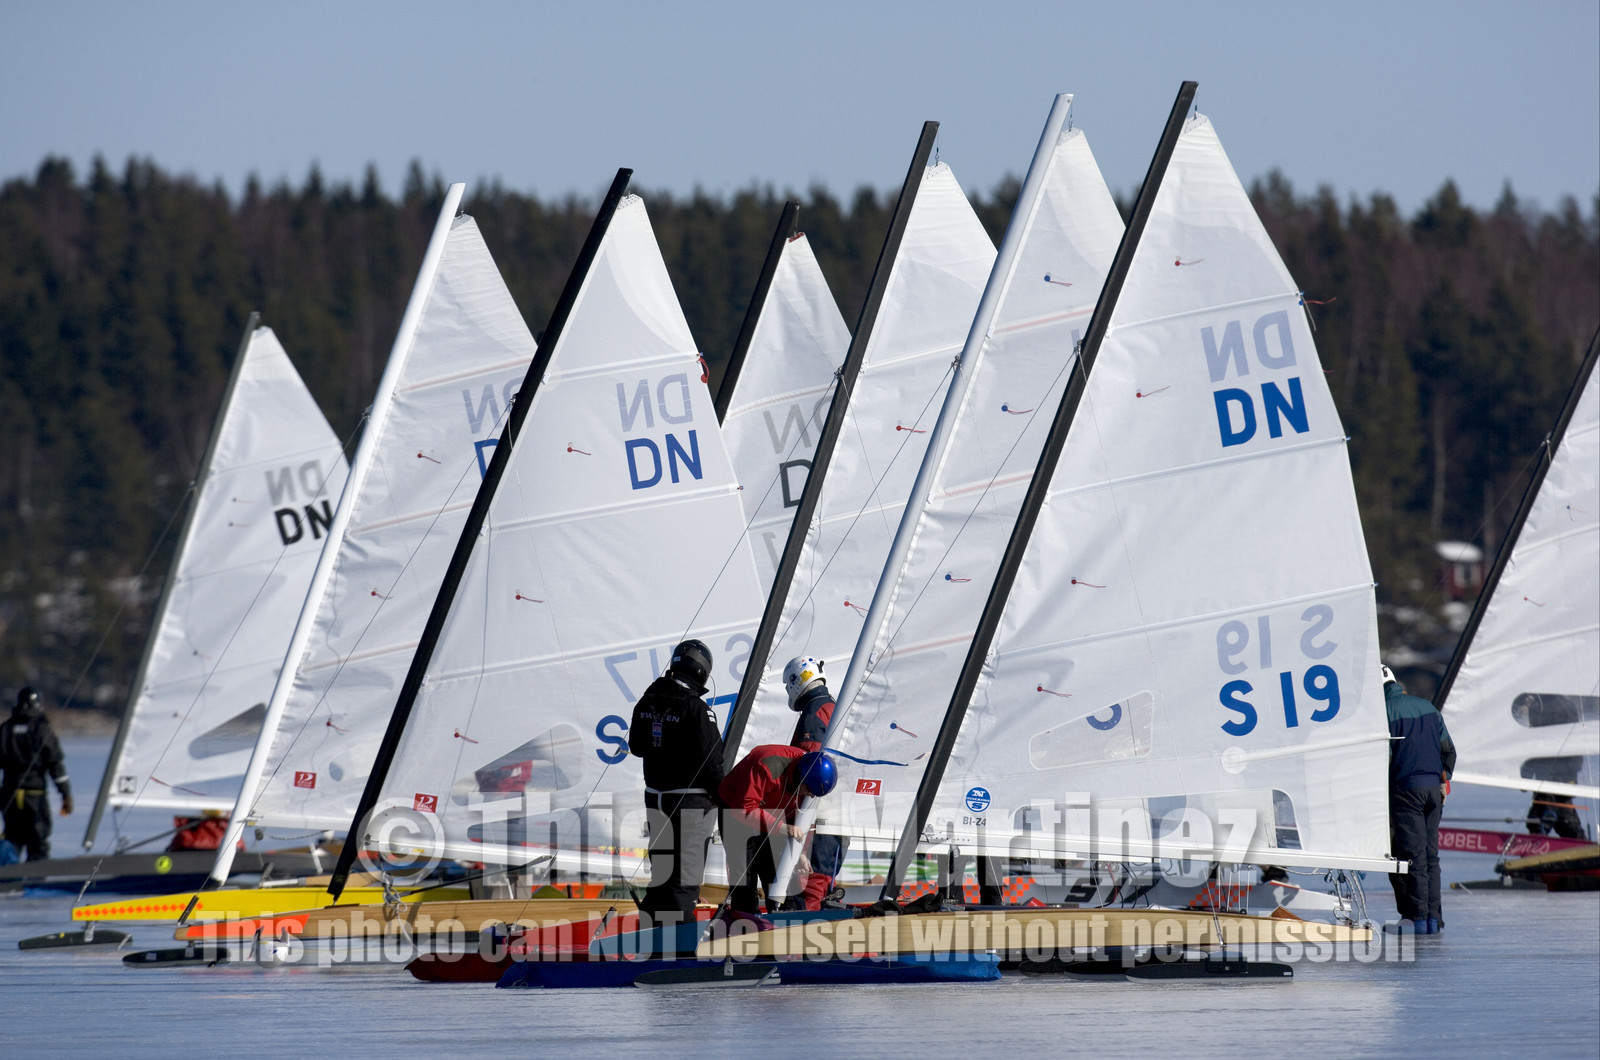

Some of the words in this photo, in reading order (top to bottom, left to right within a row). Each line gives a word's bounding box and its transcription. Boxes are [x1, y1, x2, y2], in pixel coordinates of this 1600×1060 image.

[1213, 376, 1310, 448] DN
[624, 429, 703, 490] DN
[779, 459, 814, 508] D
[274, 499, 334, 546] DN
[1219, 679, 1258, 737] S
[1280, 664, 1341, 727] 19
[595, 715, 629, 765] S
